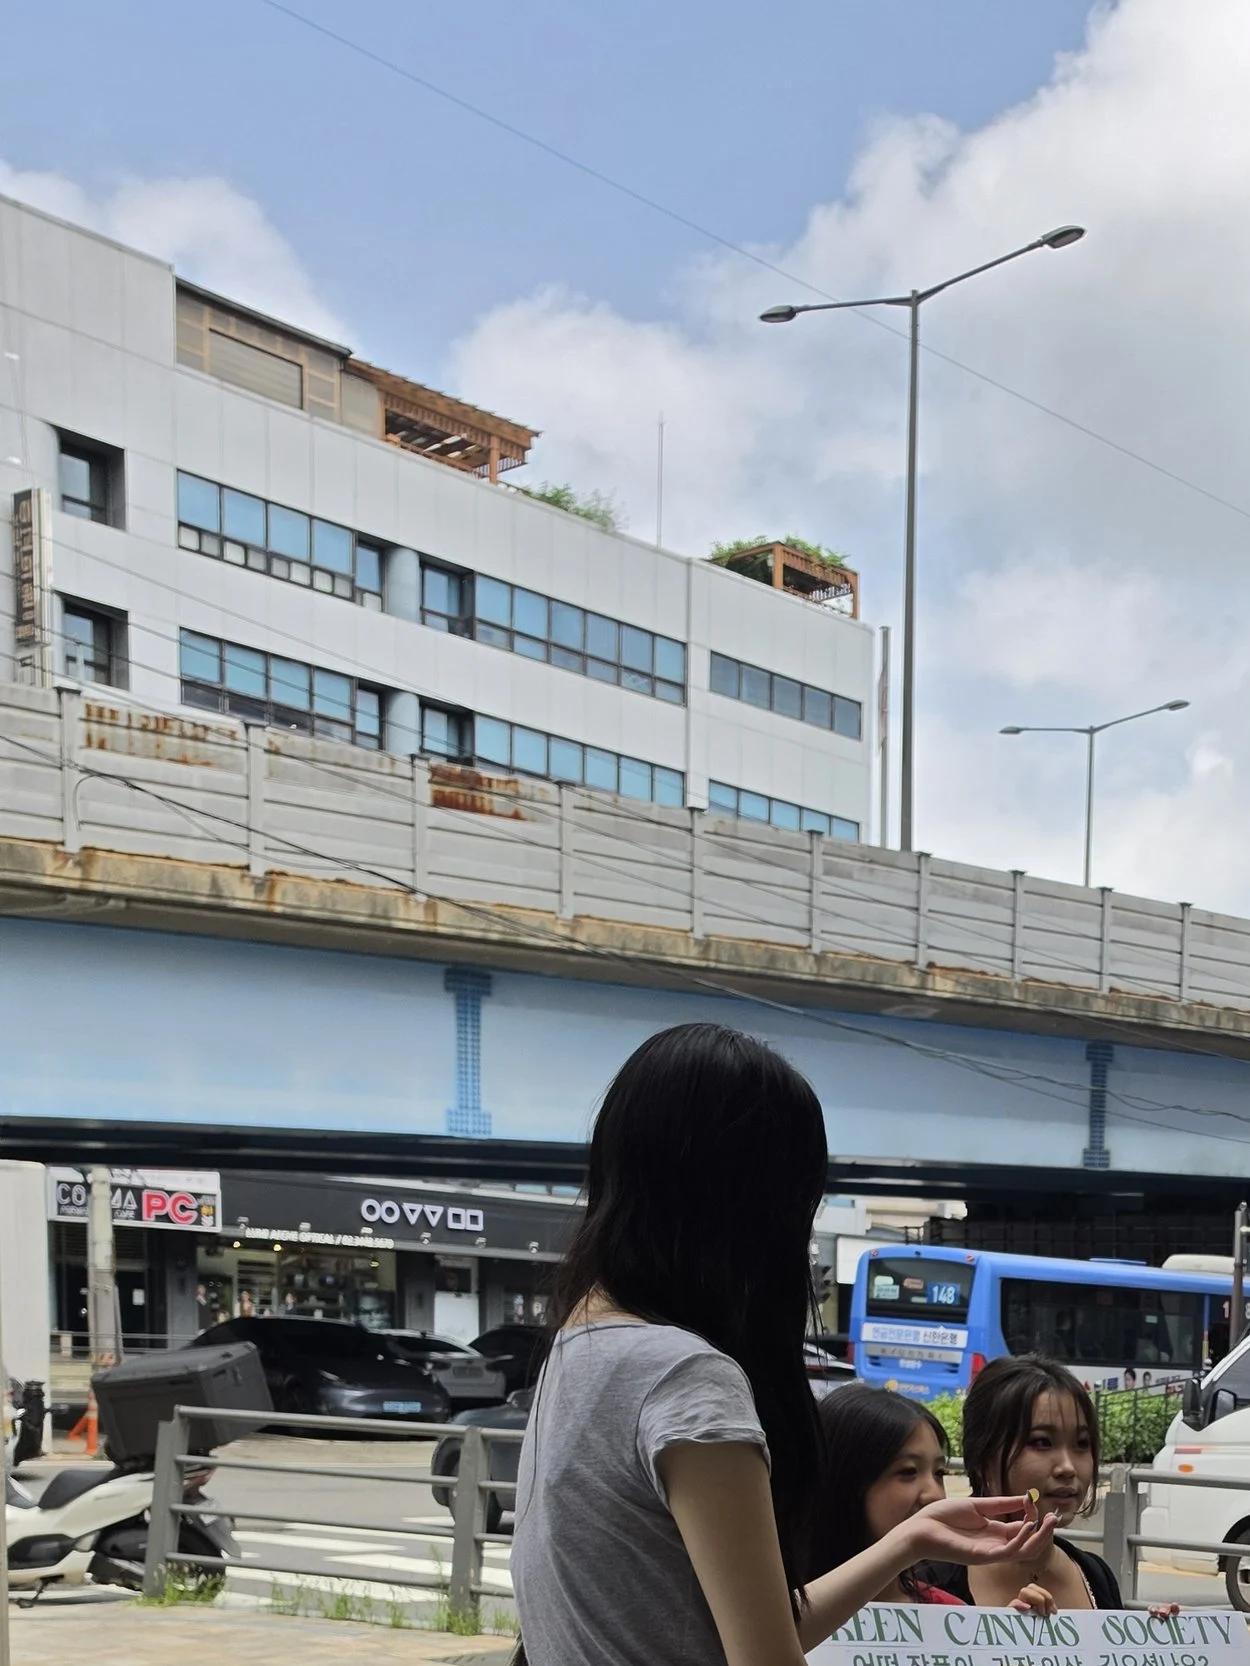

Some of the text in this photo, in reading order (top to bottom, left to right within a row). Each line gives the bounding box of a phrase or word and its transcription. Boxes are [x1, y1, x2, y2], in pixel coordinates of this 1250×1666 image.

[142, 1189, 198, 1225] PC
[932, 1285, 955, 1304] 148
[944, 1611, 1080, 1646] CANVAS
[1101, 1615, 1231, 1646] SOCIETY
